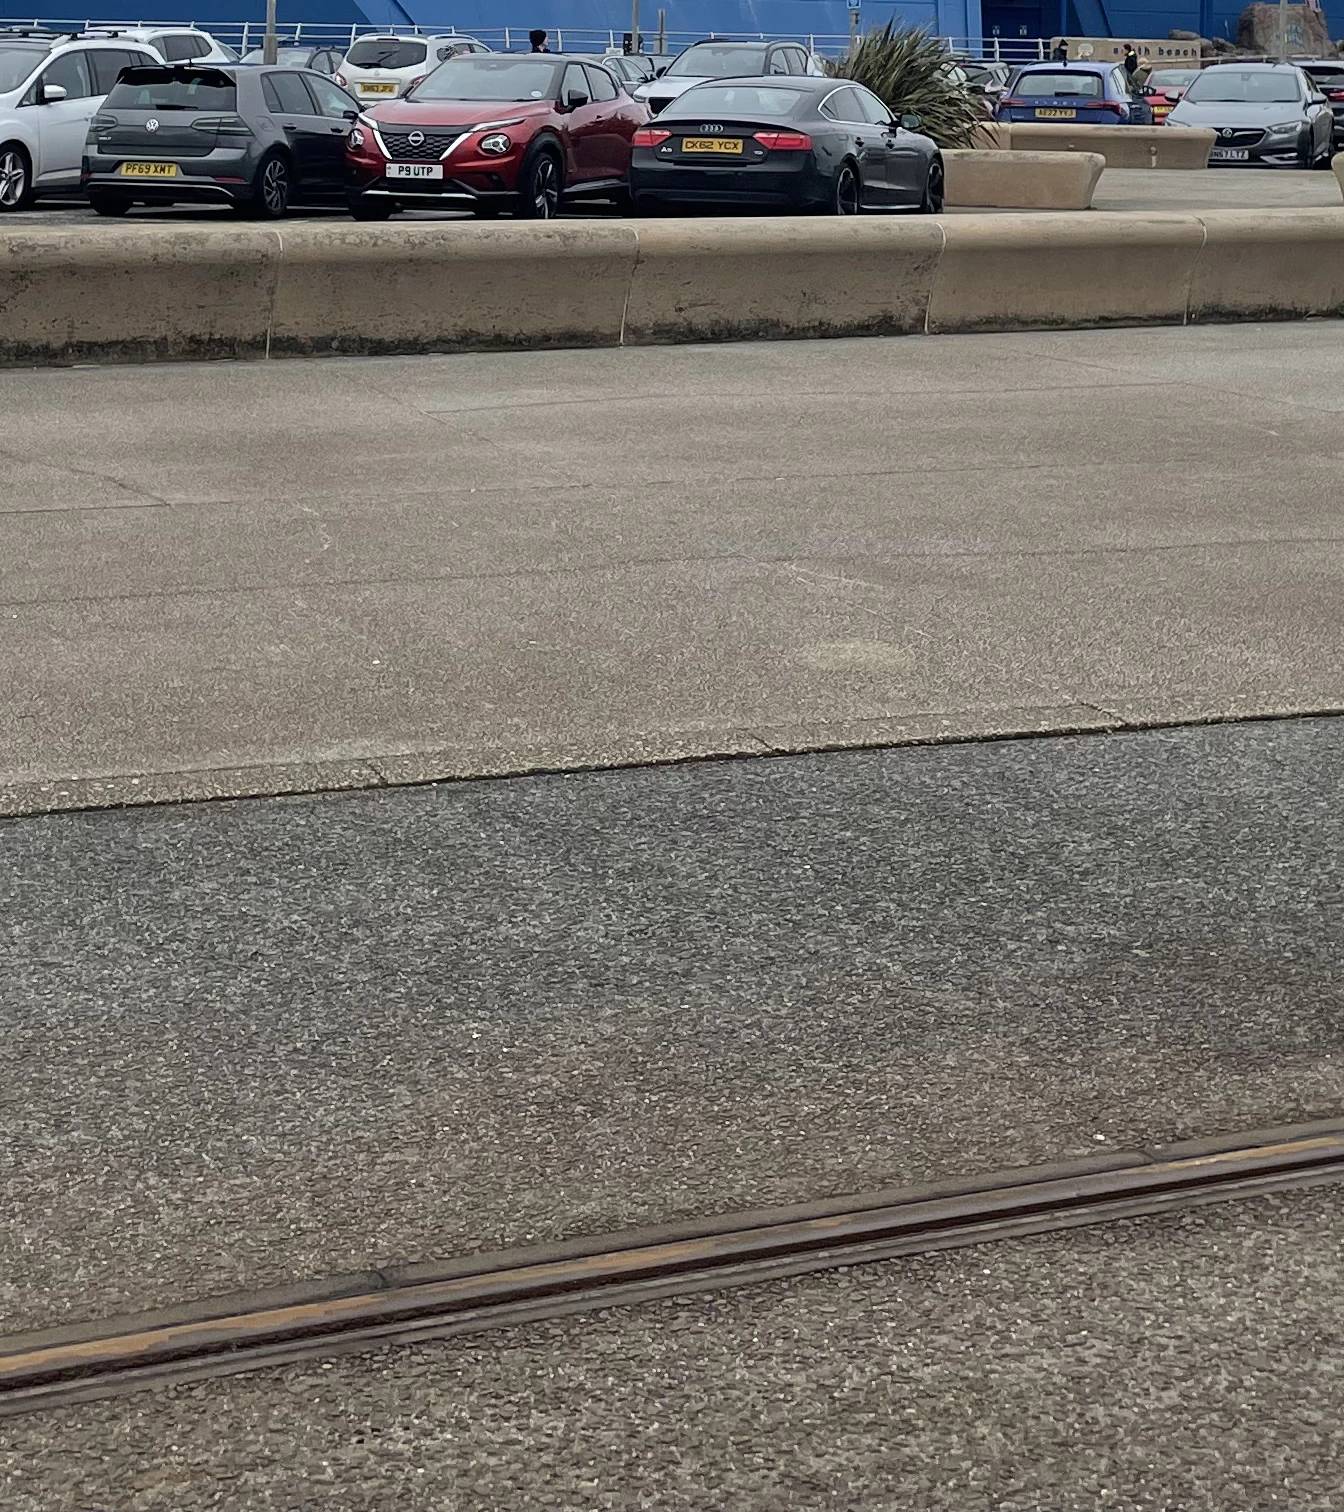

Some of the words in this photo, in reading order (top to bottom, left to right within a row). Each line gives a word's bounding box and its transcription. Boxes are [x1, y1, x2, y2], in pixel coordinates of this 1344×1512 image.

[1113, 45, 1150, 56] sth
[1158, 46, 1197, 57] beach
[718, 141, 740, 151] YCX
[1230, 150, 1246, 158] LTZ
[125, 163, 151, 174] PF69
[153, 164, 174, 174] XMT
[398, 165, 411, 176] P9
[413, 166, 434, 176] UTP
